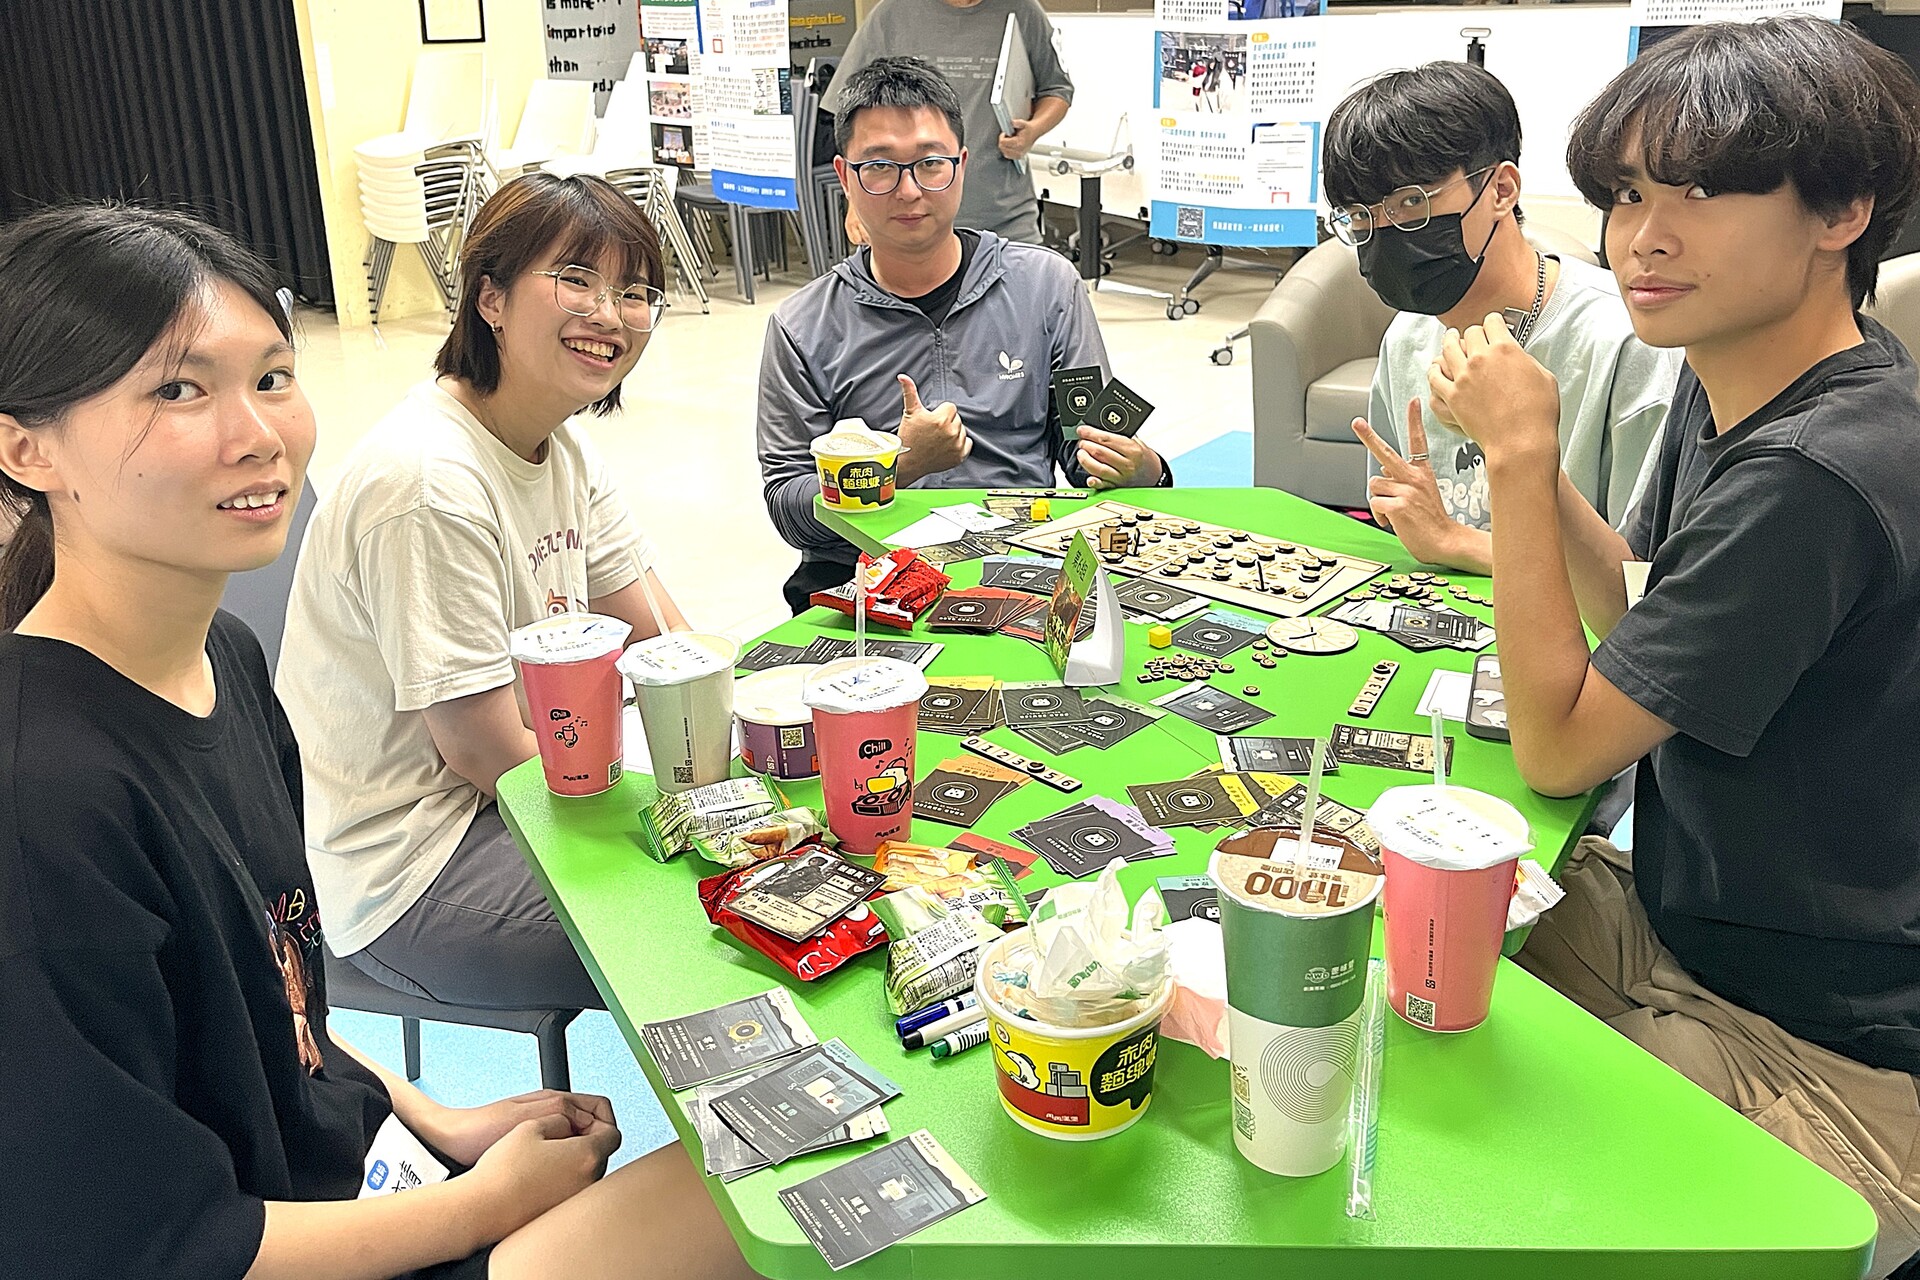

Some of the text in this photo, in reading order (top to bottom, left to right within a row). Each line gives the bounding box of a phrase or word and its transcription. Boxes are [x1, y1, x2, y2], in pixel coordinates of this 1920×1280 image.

[549, 55, 579, 74] than
[864, 742, 886, 755] Chill
[982, 744, 993, 752] 1
[997, 751, 1010, 759] 2
[1012, 758, 1025, 766] 3
[1043, 772, 1058, 780] 5
